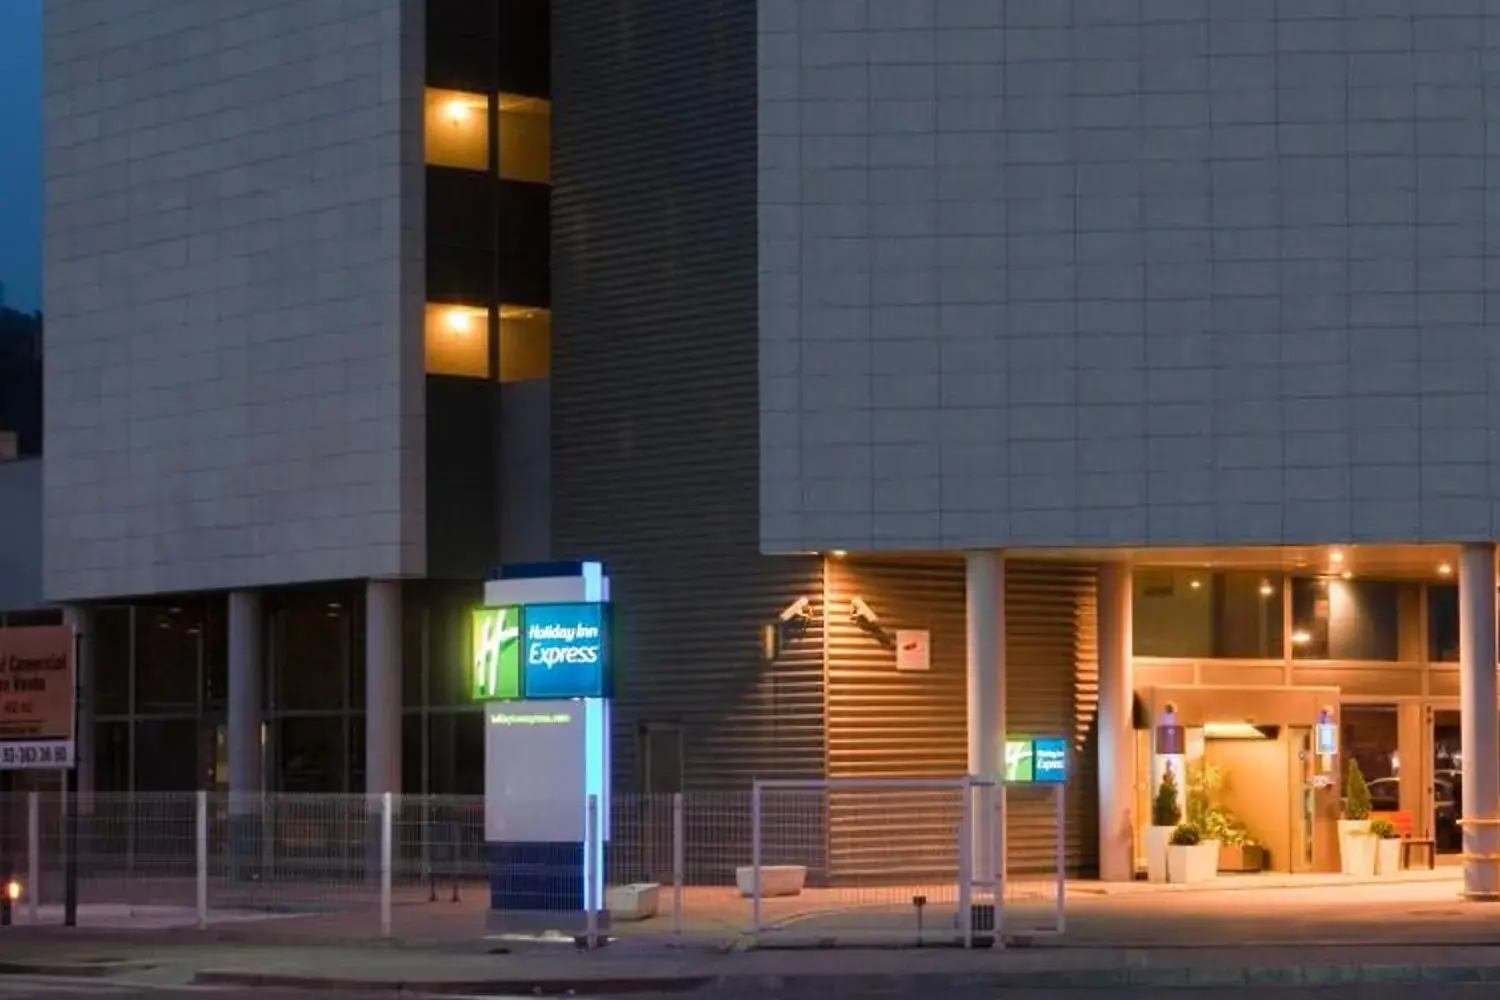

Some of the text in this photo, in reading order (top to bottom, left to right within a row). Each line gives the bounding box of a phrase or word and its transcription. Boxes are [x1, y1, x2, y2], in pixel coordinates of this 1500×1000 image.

[529, 621, 599, 642] Holiday Inn
[529, 642, 599, 670] Express
